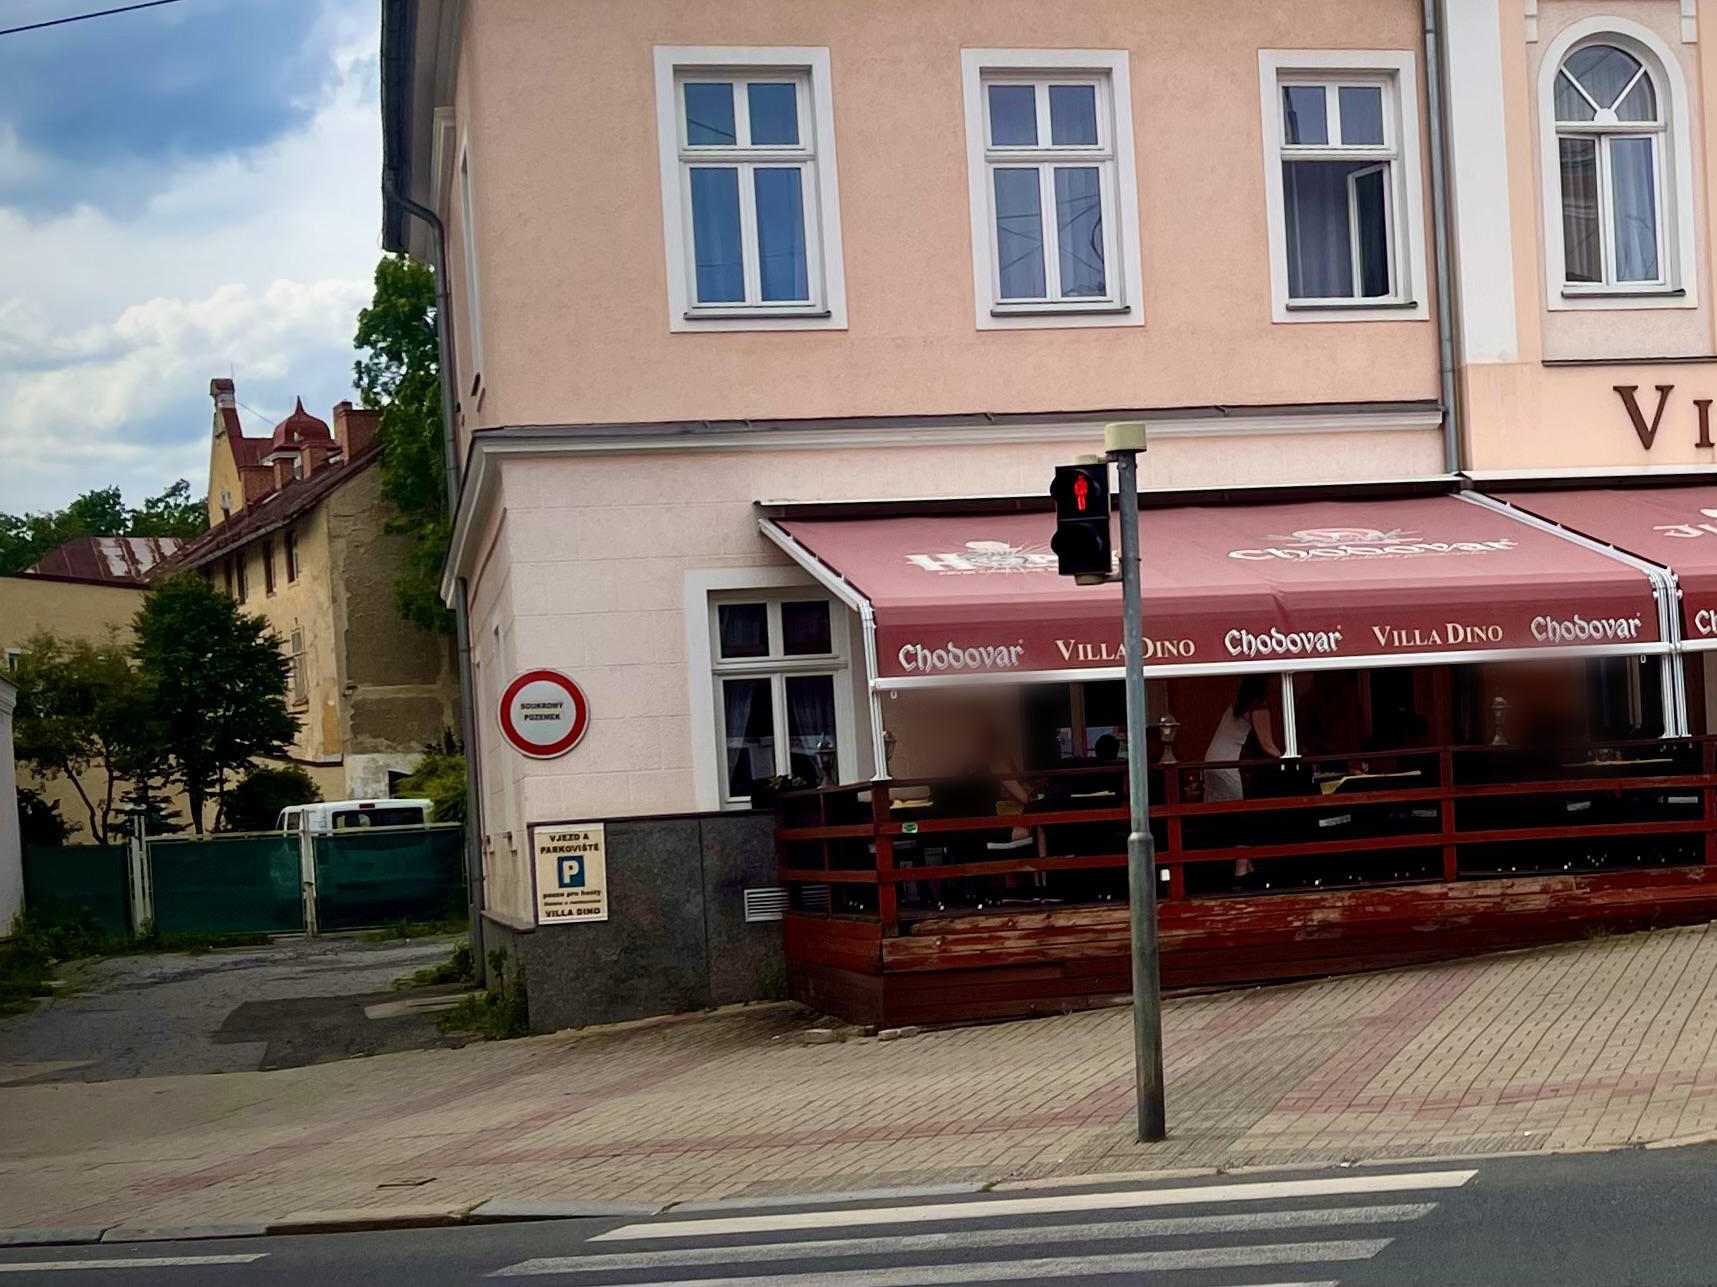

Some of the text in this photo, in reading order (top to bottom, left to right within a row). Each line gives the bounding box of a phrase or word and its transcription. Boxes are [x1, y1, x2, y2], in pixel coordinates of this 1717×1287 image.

[898, 641, 1024, 673] Chodovar
[1055, 638, 1128, 662] VILLA
[1224, 626, 1342, 658] Chodovar
[1371, 625, 1441, 647] VILLA
[1446, 622, 1503, 644] DINO
[1531, 613, 1641, 644] Chodovar
[549, 833, 581, 842] VJEZD
[562, 860, 579, 884] P
[545, 907, 600, 918] VILLA DINO
